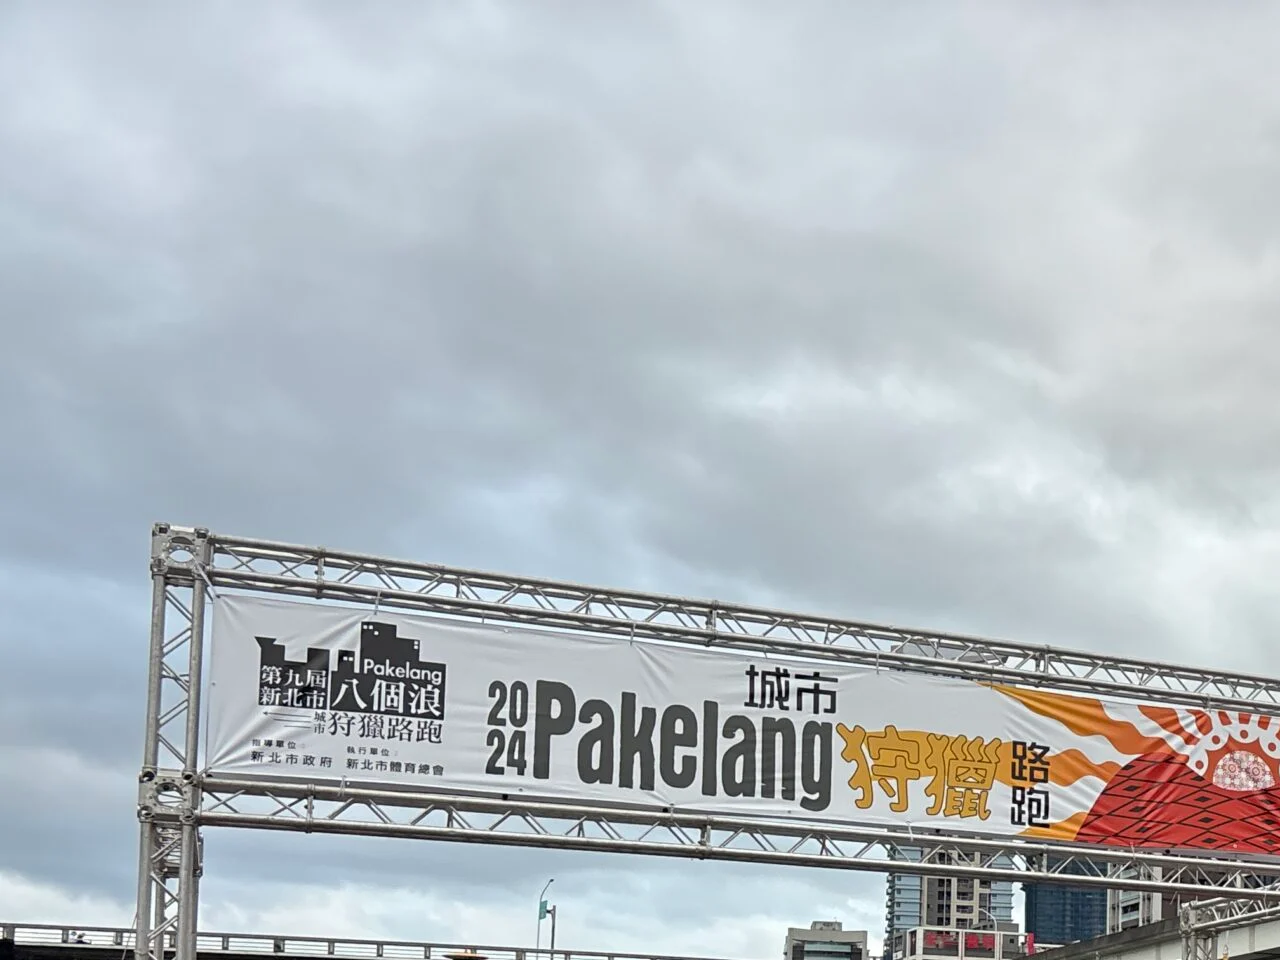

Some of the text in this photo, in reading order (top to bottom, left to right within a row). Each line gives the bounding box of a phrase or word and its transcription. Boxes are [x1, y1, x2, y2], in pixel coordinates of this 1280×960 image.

[261, 665, 327, 689] 第九屆
[364, 659, 442, 685] Pakelang
[744, 664, 839, 715] 城市
[260, 686, 326, 709] 新北市
[332, 678, 442, 716] 八個浪
[487, 680, 529, 728] 20
[328, 712, 442, 744] 狩獵路跑
[533, 679, 834, 812] Pakelang
[250, 751, 333, 768] 新北市政府
[346, 759, 444, 776] 新北市體育總會
[486, 729, 527, 776] 24
[836, 722, 1002, 821] 狩獵
[1011, 739, 1050, 829] 路跑
